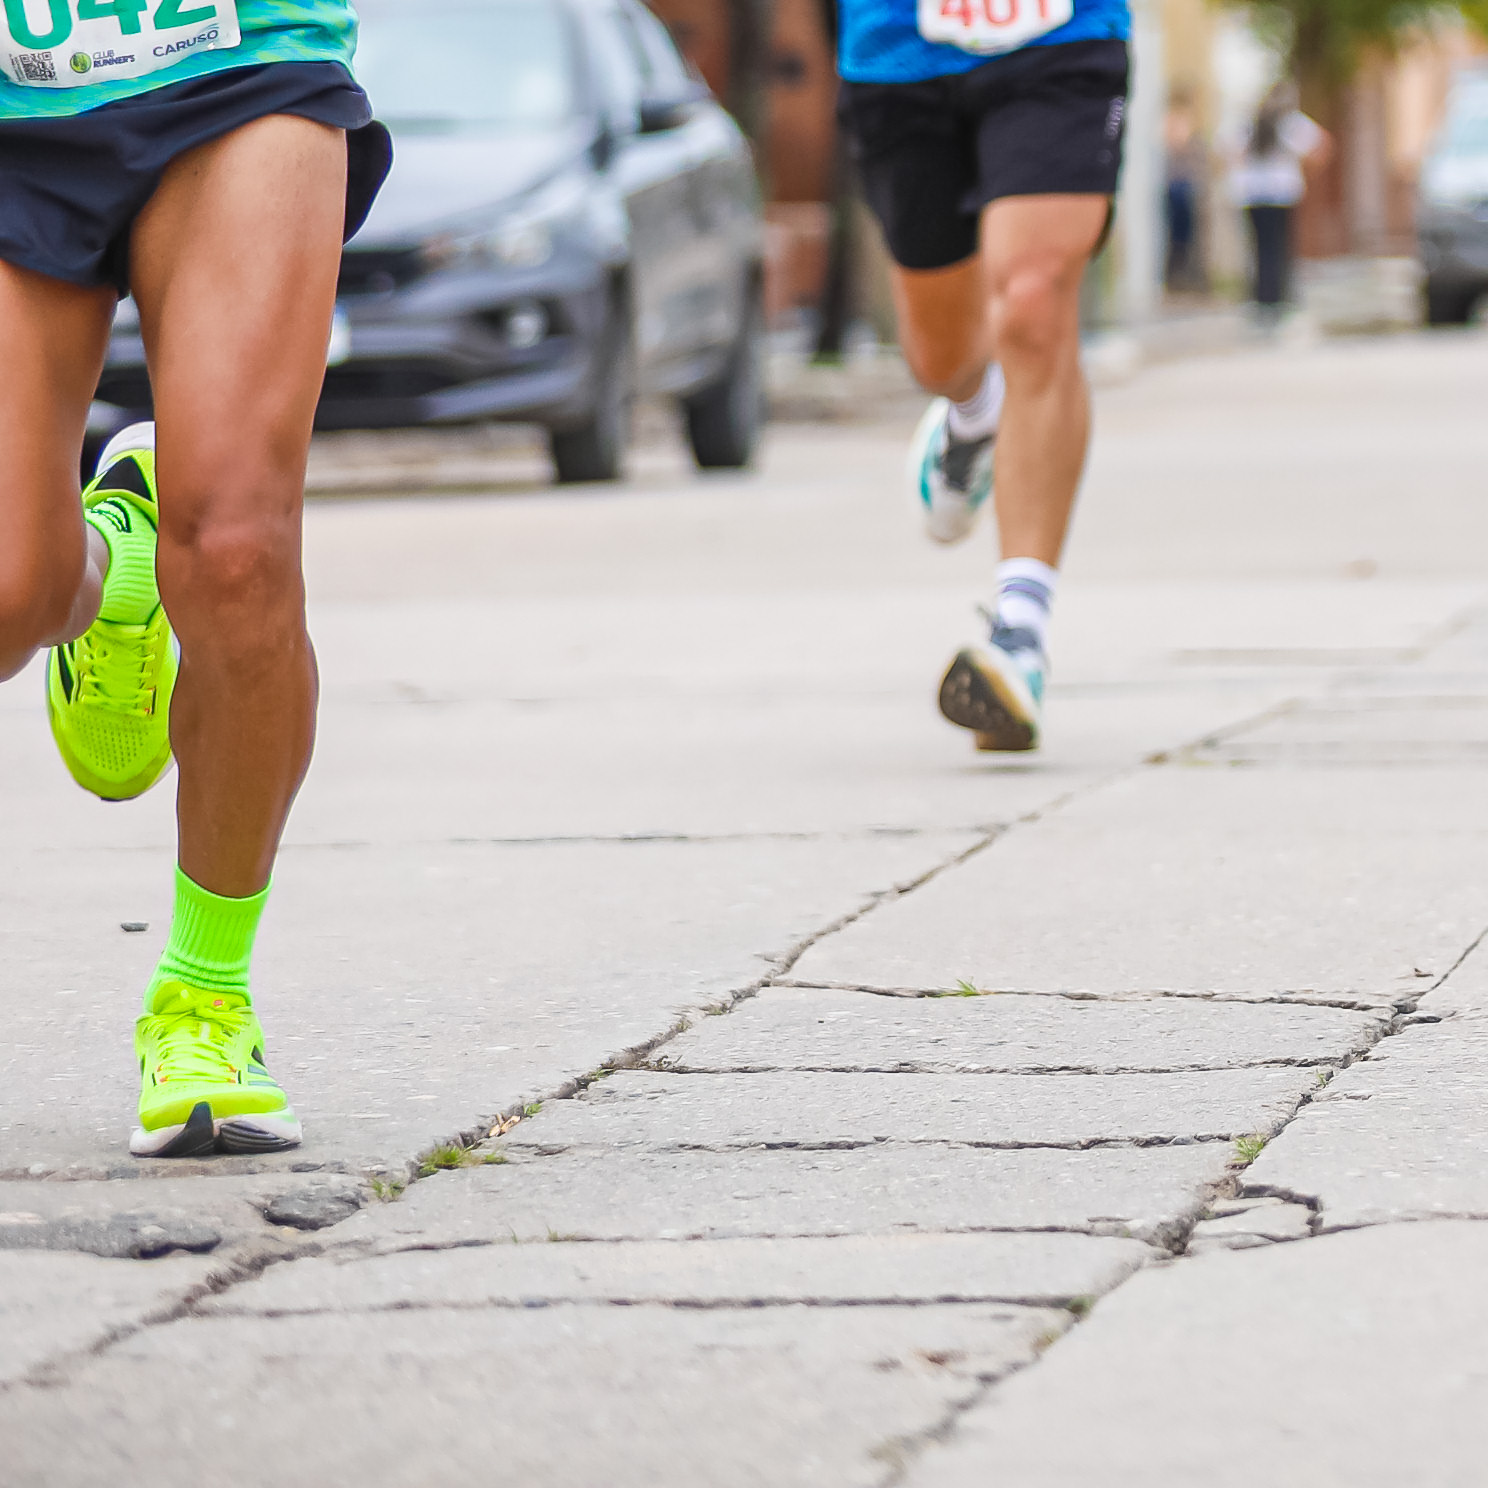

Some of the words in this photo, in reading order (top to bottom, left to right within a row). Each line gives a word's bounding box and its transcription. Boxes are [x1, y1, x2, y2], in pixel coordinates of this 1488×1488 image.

[152, 29, 219, 57] CARUSO
[93, 49, 115, 60] CLUB
[93, 54, 136, 68] RUNNER'S
